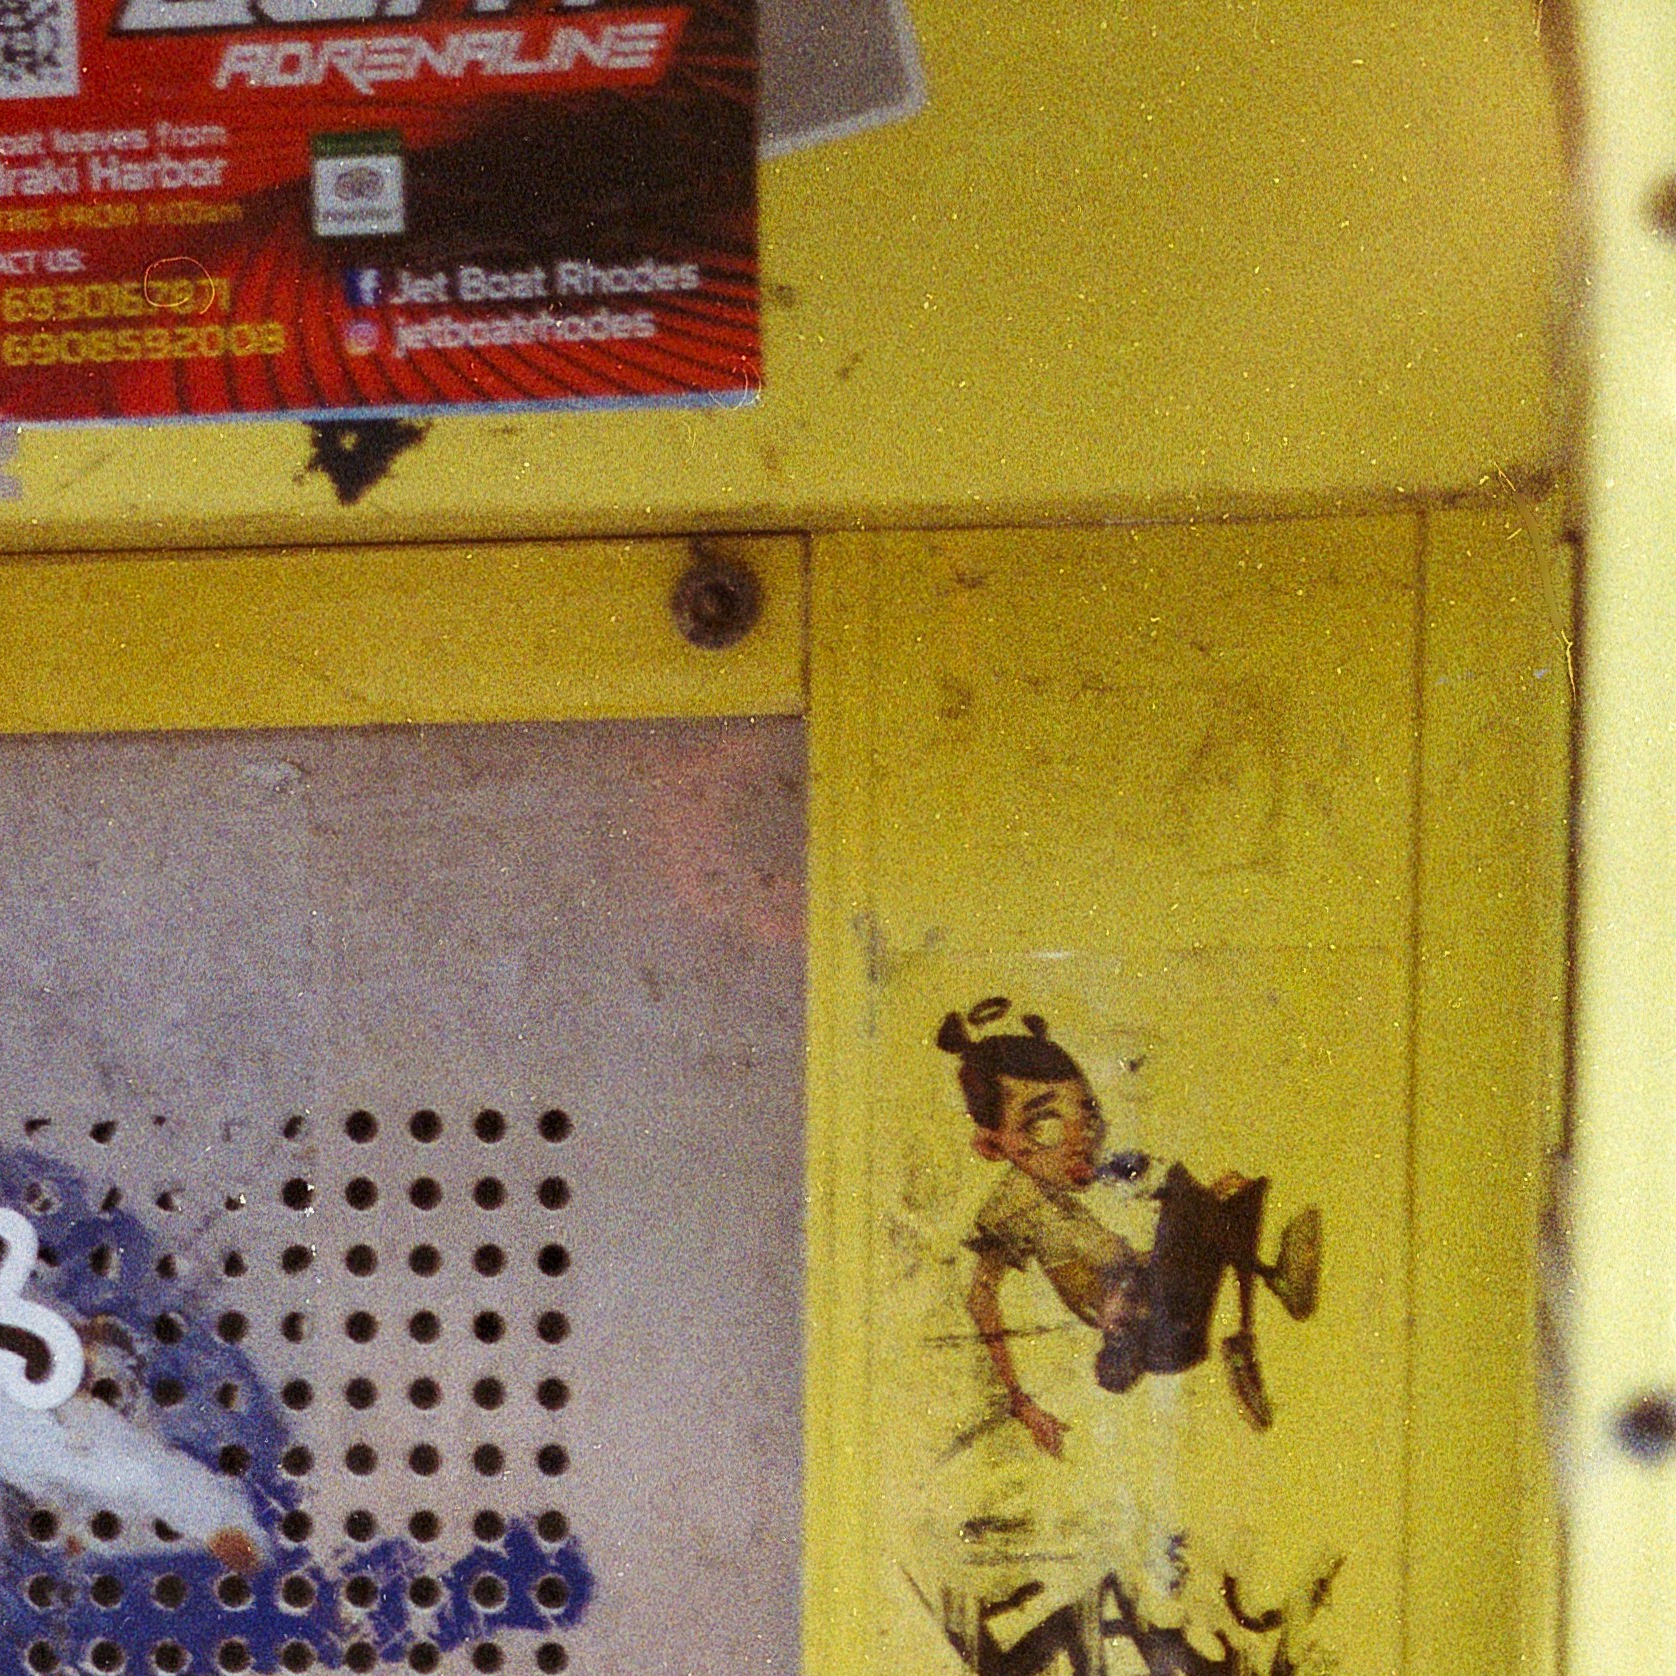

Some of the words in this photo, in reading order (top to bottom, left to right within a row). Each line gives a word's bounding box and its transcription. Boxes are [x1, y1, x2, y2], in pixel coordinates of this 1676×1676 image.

[212, 22, 666, 94] ADRENALINE
[53, 126, 149, 155] leaves
[156, 121, 228, 148] from
[88, 154, 229, 191] Harbor
[391, 270, 451, 305] Jet
[458, 263, 547, 300] Boat
[555, 257, 701, 295] Rhodes
[391, 306, 657, 359] jetboatrhodes
